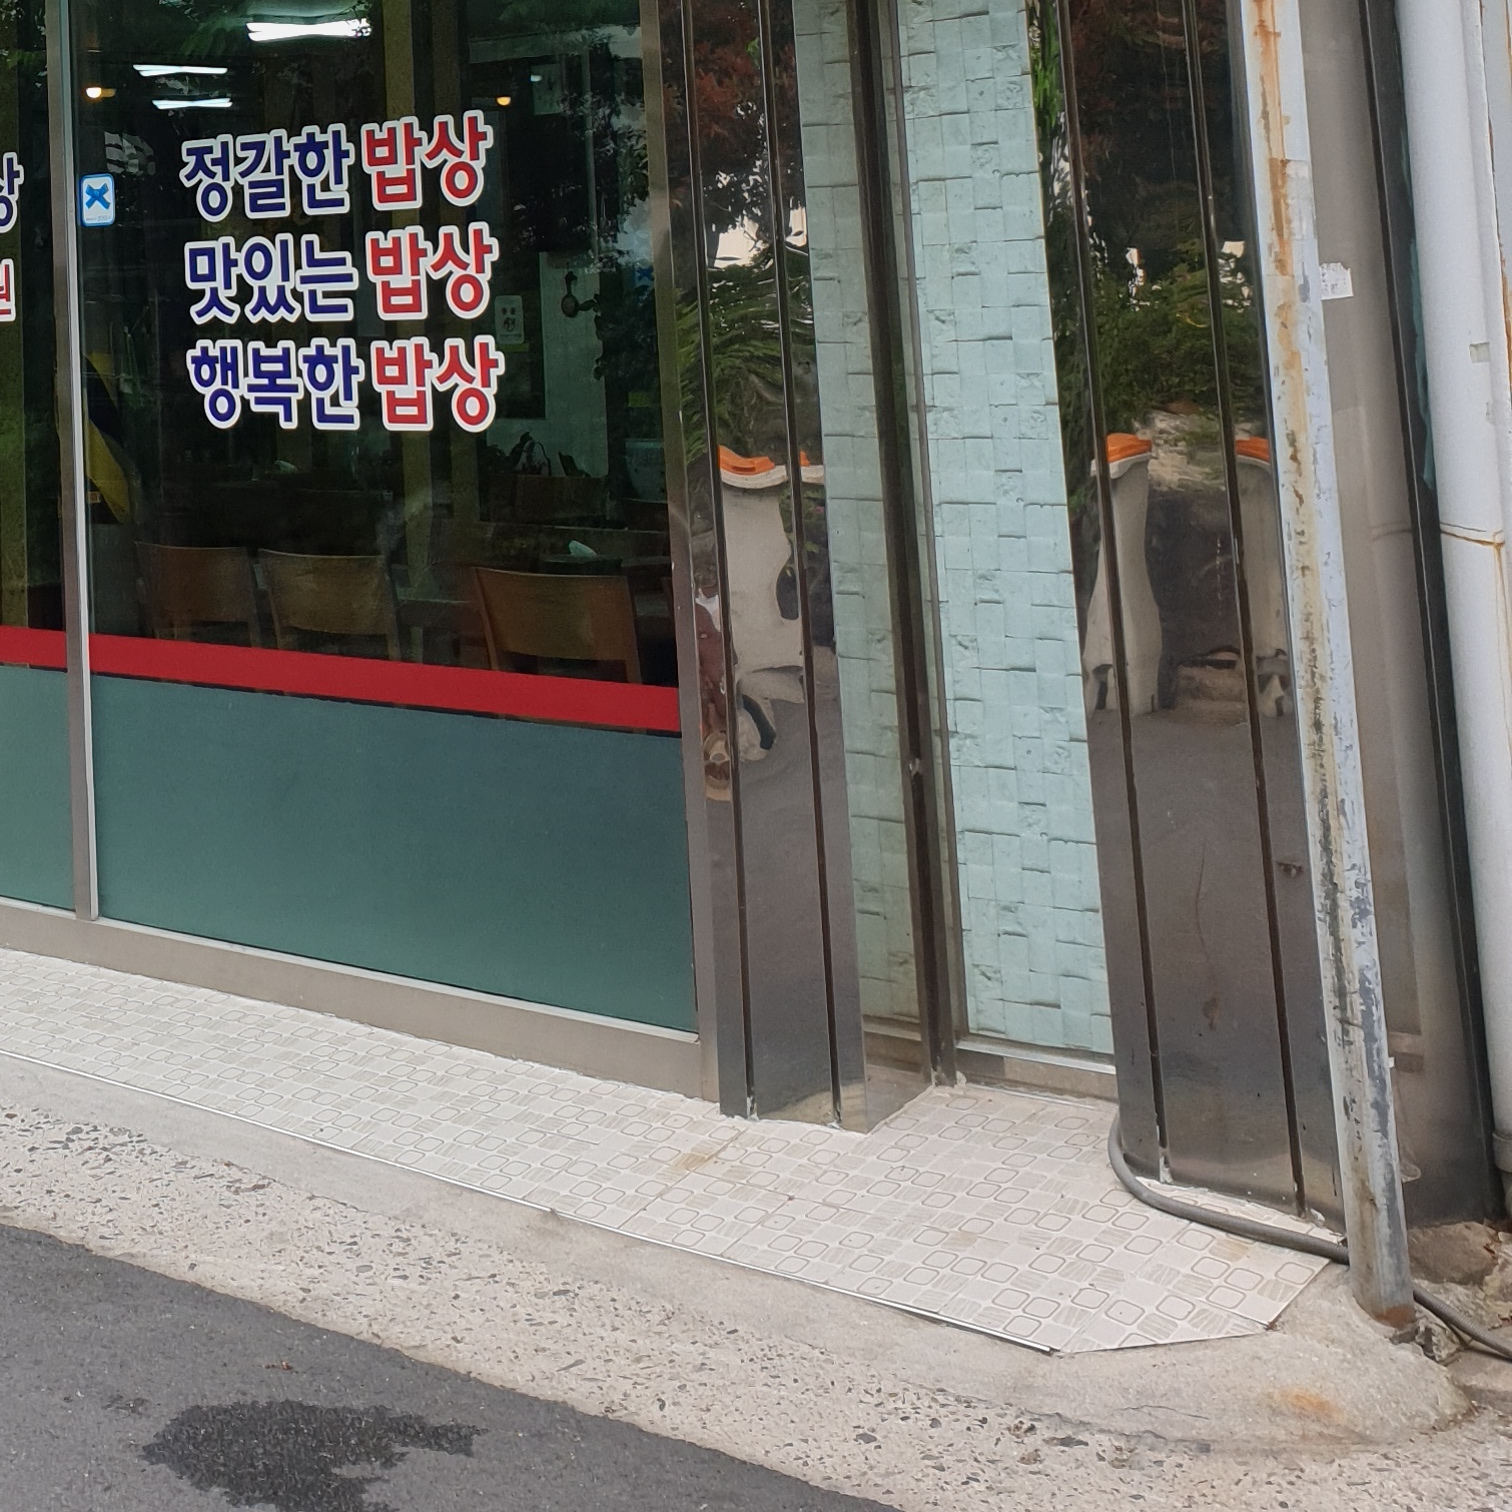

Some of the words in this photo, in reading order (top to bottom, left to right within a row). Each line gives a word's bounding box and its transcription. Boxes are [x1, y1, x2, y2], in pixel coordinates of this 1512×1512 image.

[180, 124, 353, 221] 정갈한
[361, 110, 493, 210] 밥상
[185, 233, 357, 324] 맛있는
[367, 222, 498, 320] 밥상
[188, 337, 363, 429] 행복한
[372, 335, 504, 432] 밥상
